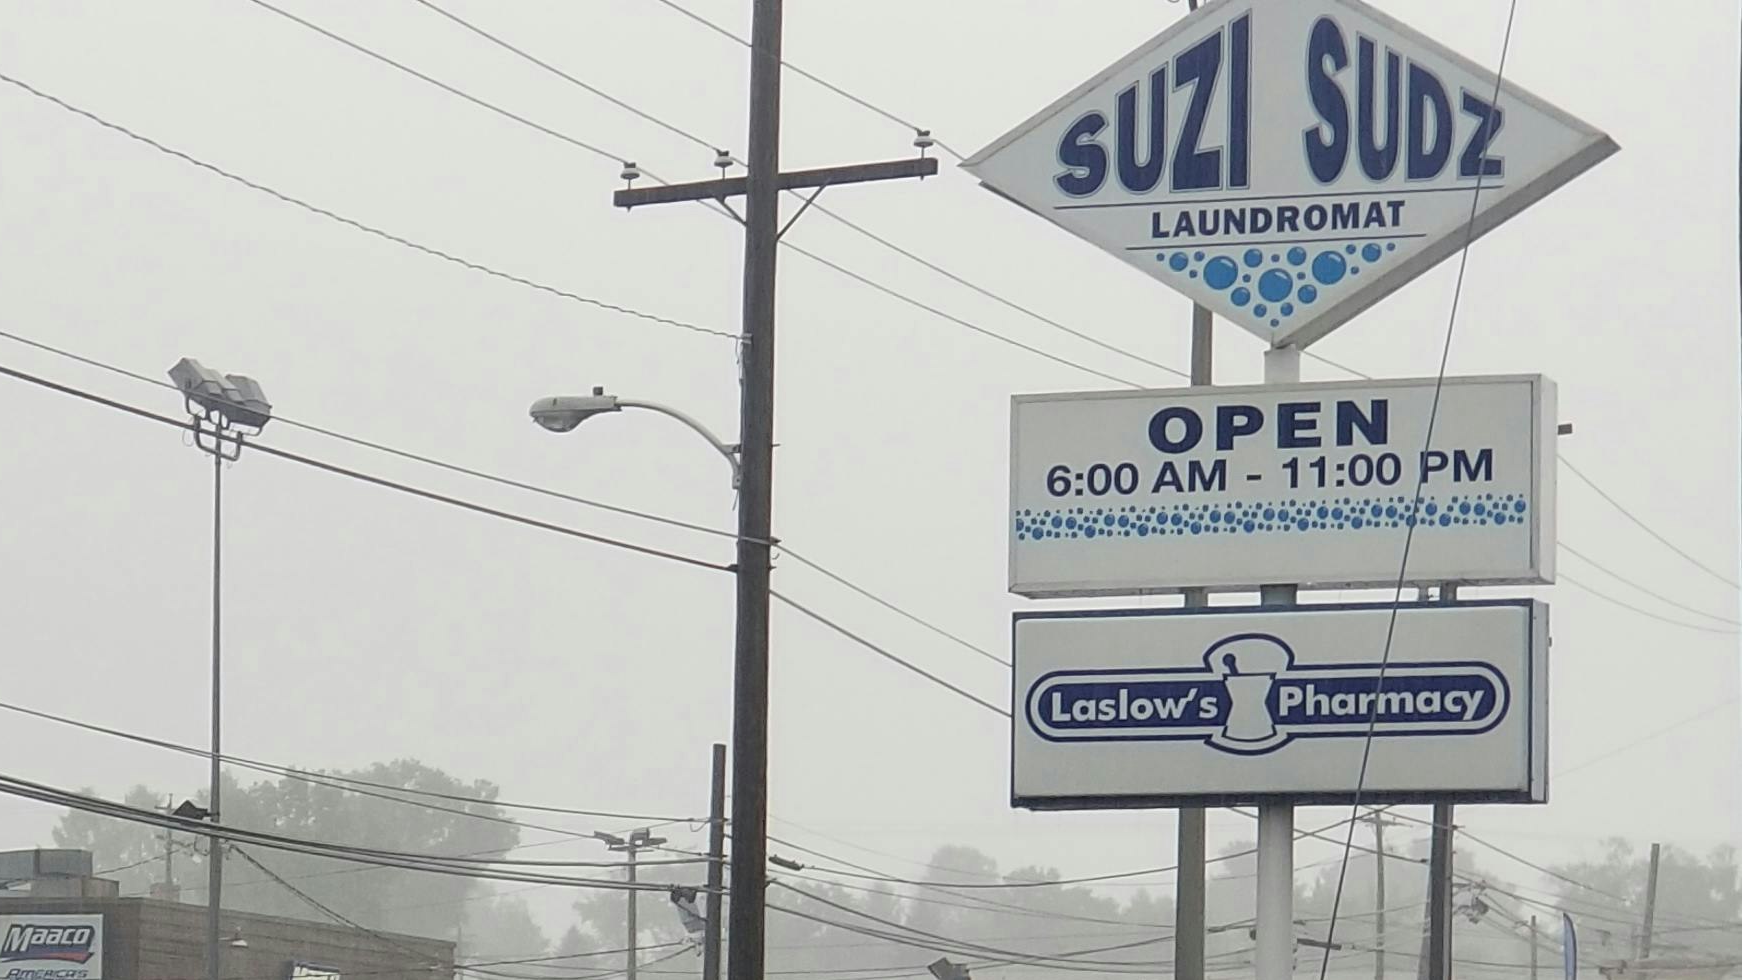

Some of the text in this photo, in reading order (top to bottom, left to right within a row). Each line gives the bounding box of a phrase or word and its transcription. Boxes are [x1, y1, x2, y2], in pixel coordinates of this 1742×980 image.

[1053, 7, 1505, 198] SUZI SUDZ
[1151, 199, 1405, 239] LAUNDROMAT
[1147, 398, 1389, 454] OPEN
[1045, 462, 1140, 498] 6:00
[1151, 458, 1227, 494] AM
[1282, 452, 1402, 489] 11:00
[1419, 447, 1494, 485] PM
[1050, 684, 1485, 722] Laslow's Pharmacy
